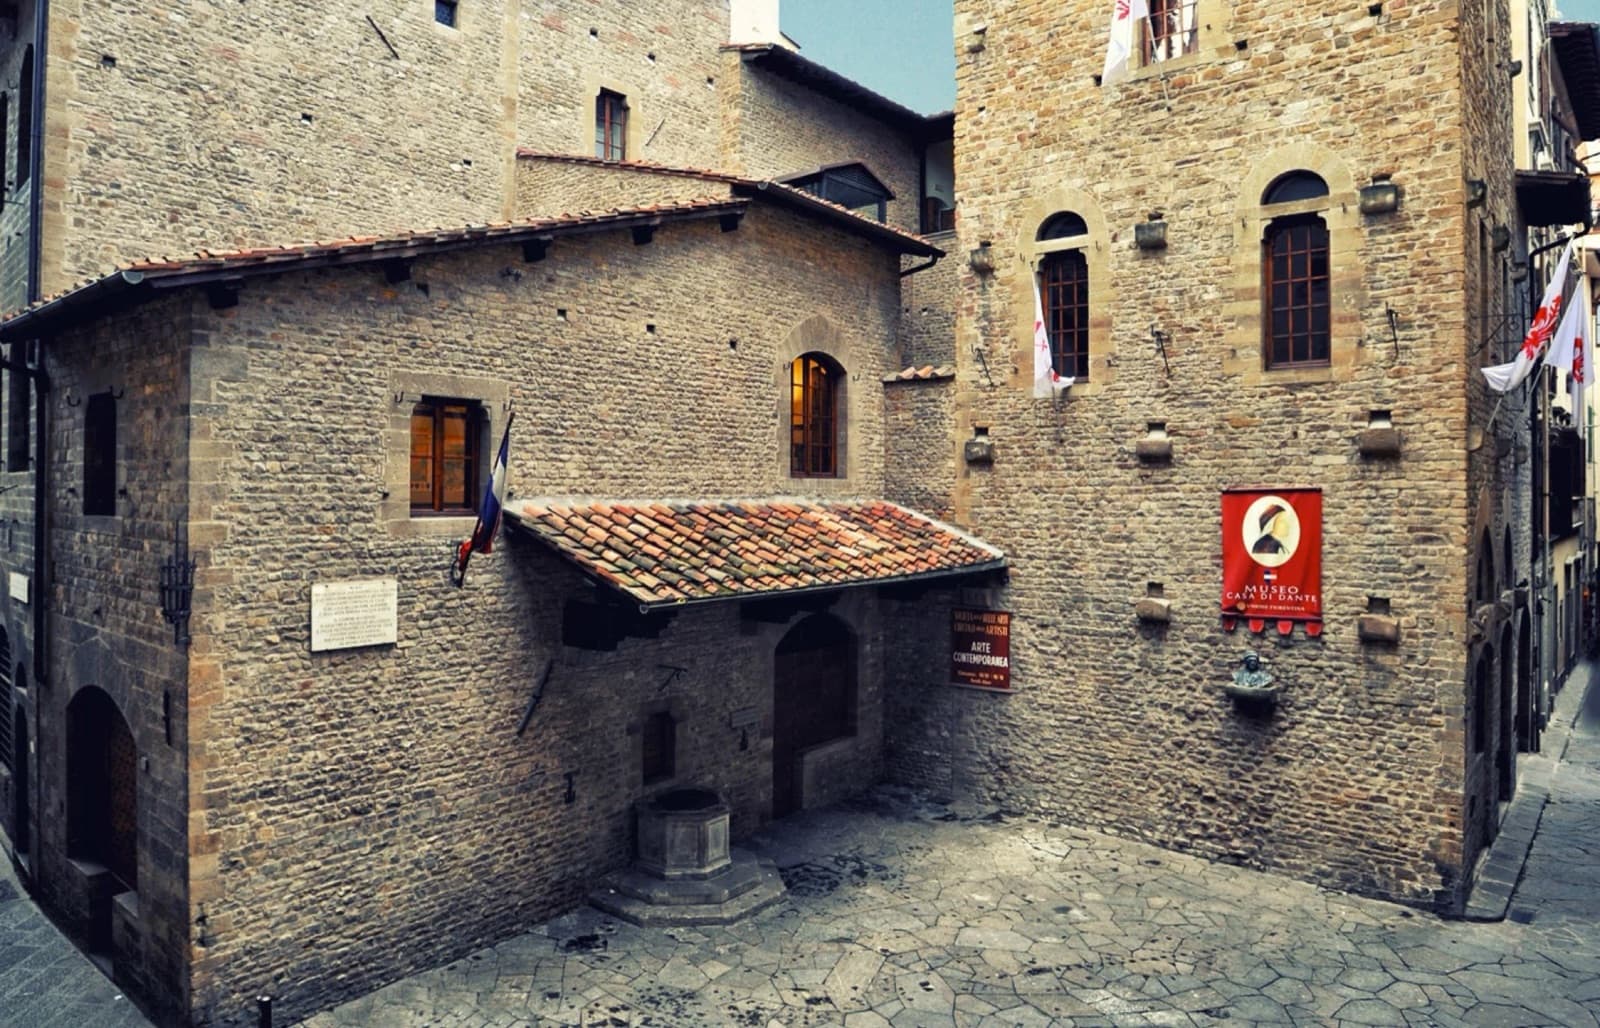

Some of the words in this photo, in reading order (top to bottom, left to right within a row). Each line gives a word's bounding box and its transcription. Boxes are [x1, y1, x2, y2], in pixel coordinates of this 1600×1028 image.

[1244, 585, 1298, 594] MUSEO
[1226, 592, 1255, 600] CASA
[971, 641, 991, 653] ARTE
[953, 651, 1008, 667] CONTEMPORANEA
